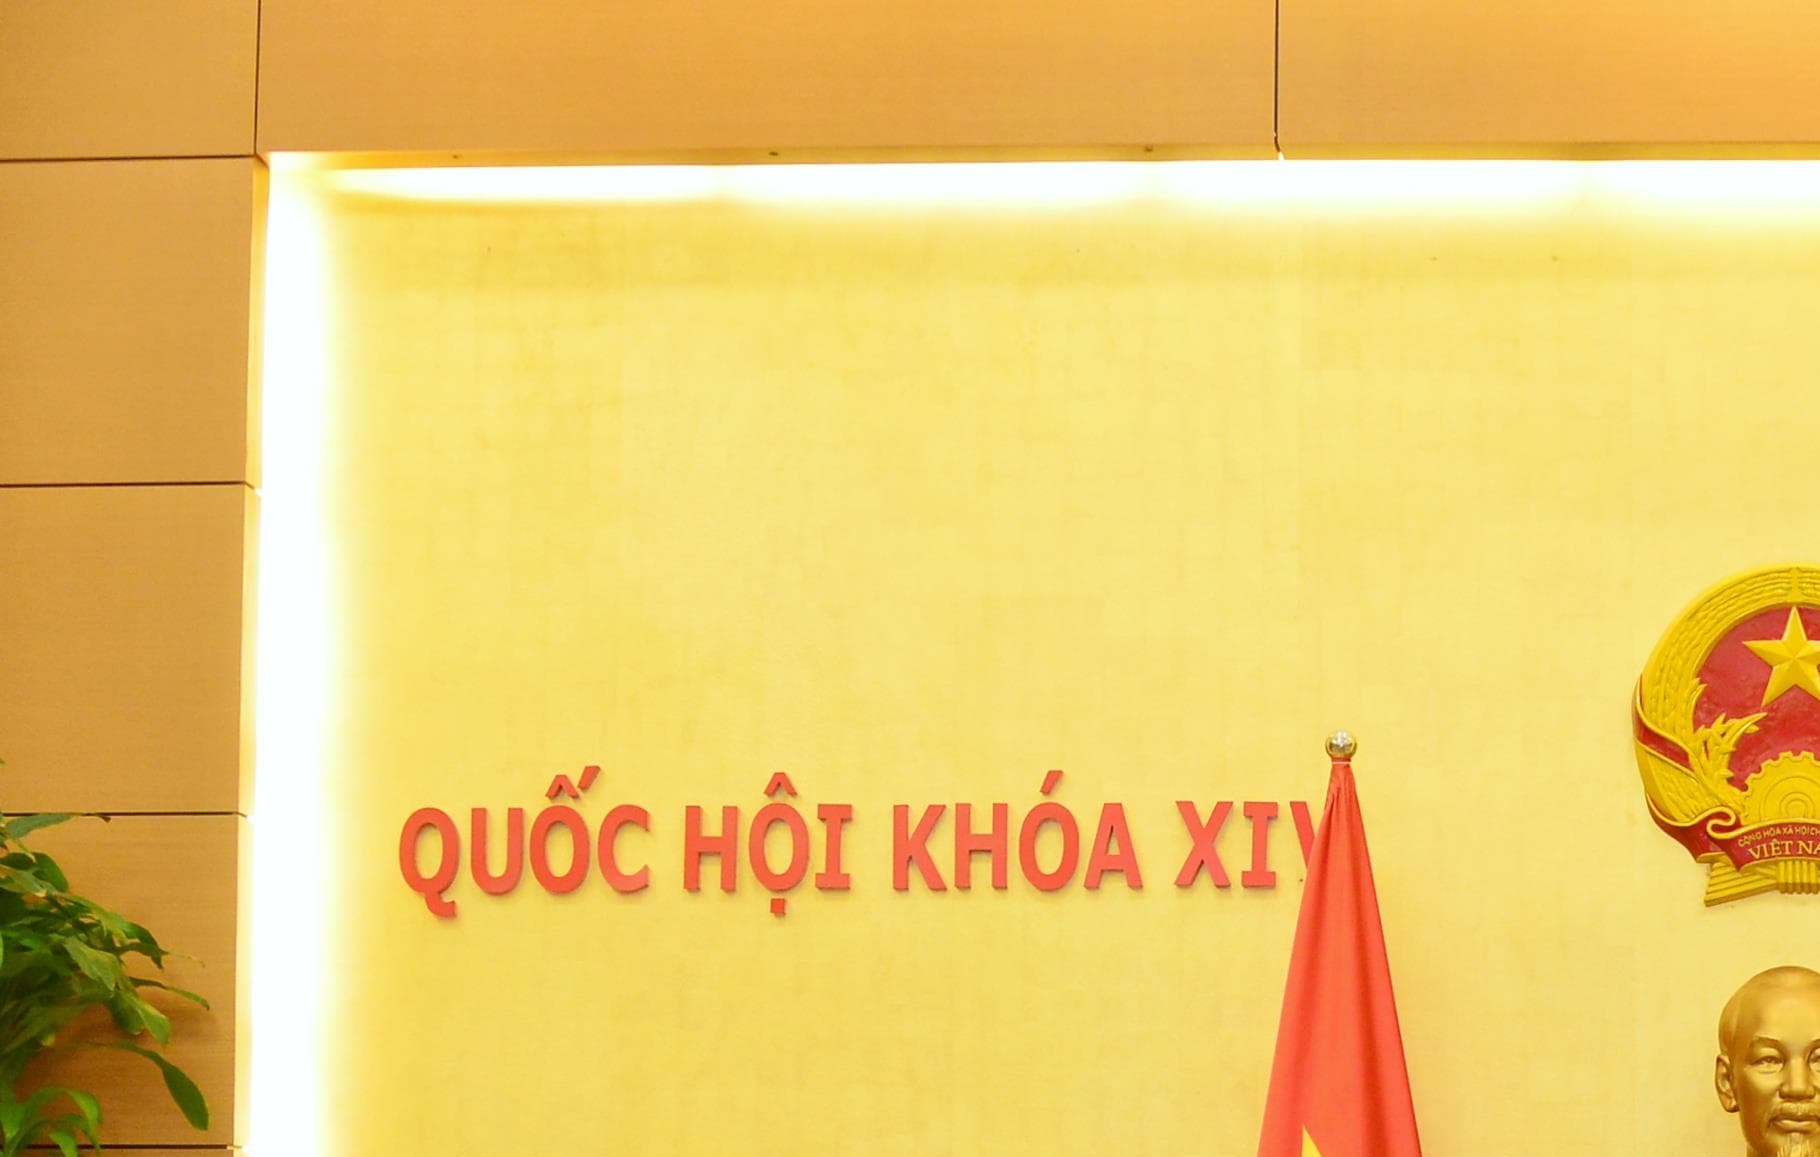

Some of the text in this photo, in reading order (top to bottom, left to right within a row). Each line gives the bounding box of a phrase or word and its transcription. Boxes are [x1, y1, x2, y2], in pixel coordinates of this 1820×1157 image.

[399, 766, 650, 919] QUỐC
[683, 772, 853, 916] HỘI
[893, 770, 1143, 892] KHÓA
[1738, 832, 1762, 847] CỘNG
